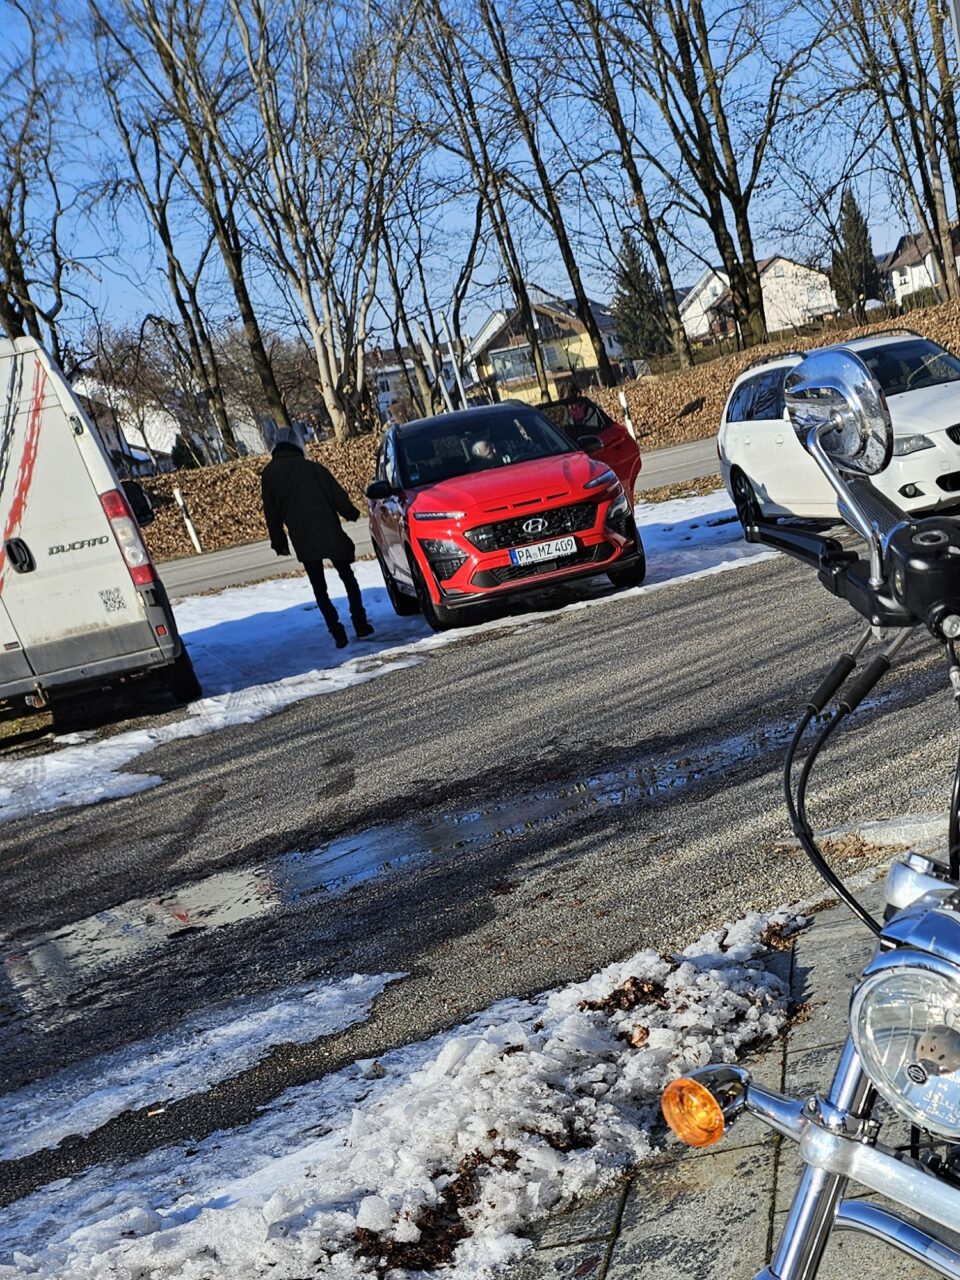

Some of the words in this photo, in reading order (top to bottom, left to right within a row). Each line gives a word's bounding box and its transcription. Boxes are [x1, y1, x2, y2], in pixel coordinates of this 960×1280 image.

[48, 535, 110, 556] DUCATO
[517, 549, 533, 562] PA
[537, 543, 553, 557] MZ
[554, 539, 574, 554] 409
